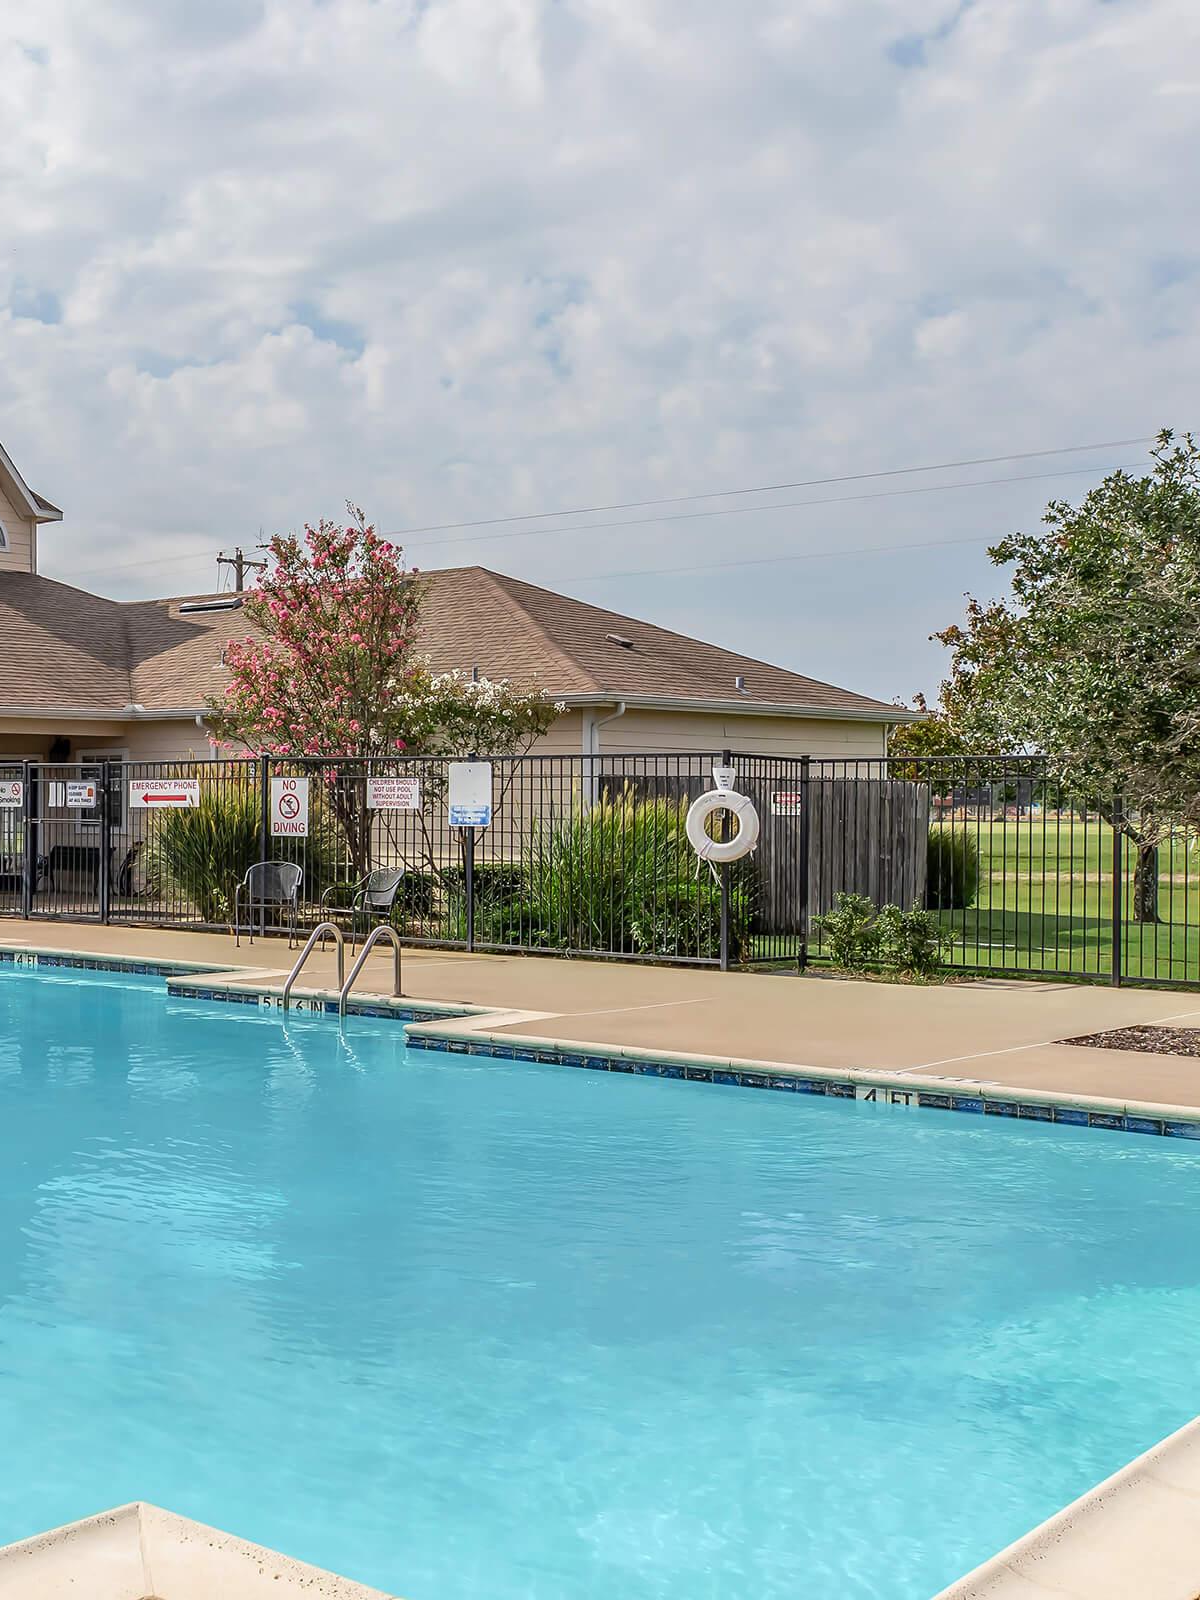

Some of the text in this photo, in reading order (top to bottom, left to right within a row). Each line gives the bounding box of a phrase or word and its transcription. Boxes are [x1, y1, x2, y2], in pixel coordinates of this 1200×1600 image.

[131, 781, 197, 790] EMERGENCY PHONE
[282, 780, 297, 790] NO
[273, 822, 306, 833] DIVING
[17, 954, 36, 964] 4 FT
[263, 996, 271, 1009] 5
[311, 1001, 323, 1012] IN
[891, 1091, 914, 1106] FT
